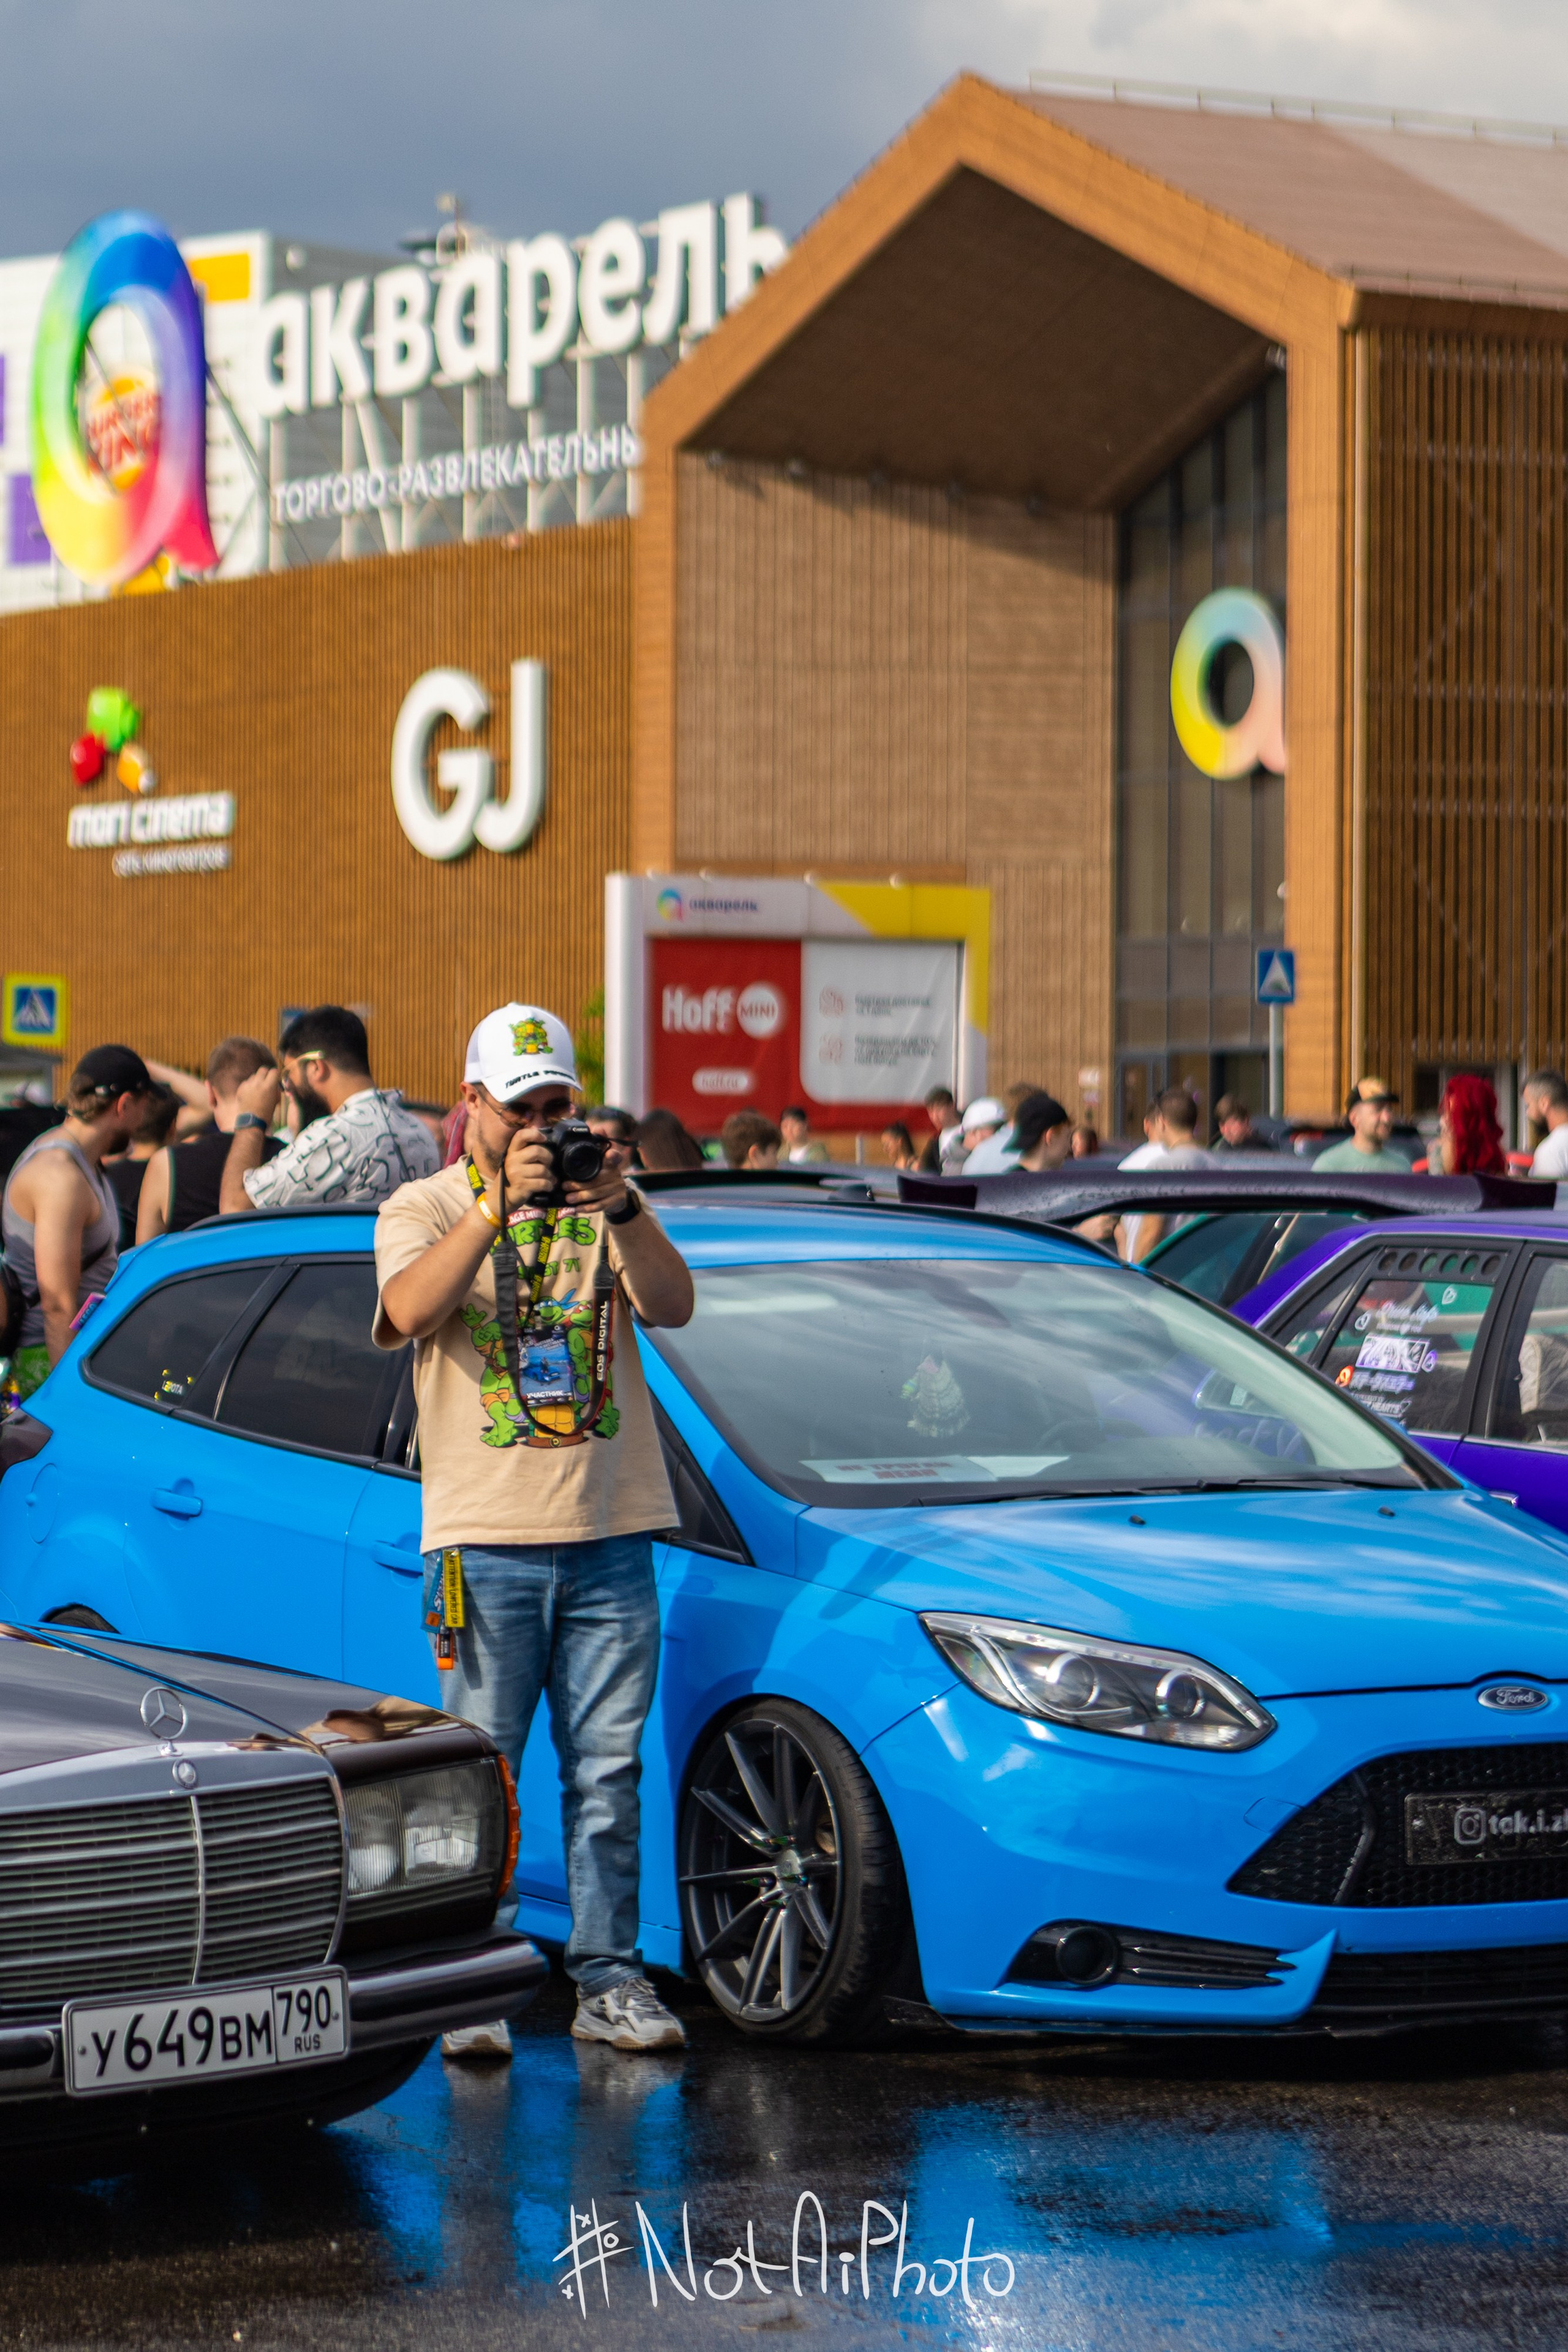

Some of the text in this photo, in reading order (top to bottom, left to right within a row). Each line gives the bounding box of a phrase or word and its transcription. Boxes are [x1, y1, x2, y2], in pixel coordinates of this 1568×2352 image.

[260, 191, 790, 419] акварель
[391, 657, 545, 861] GJ
[130, 790, 235, 843] cinema
[662, 984, 775, 1034] Hoff MINI
[598, 1301, 608, 1350] DIGITAL
[526, 1390, 563, 1399] УЧАСТНИК
[449, 1589, 458, 1613] LOWERED
[1496, 1688, 1536, 1705] Ford
[276, 1986, 331, 2036] 790
[294, 2034, 321, 2054] RUS
